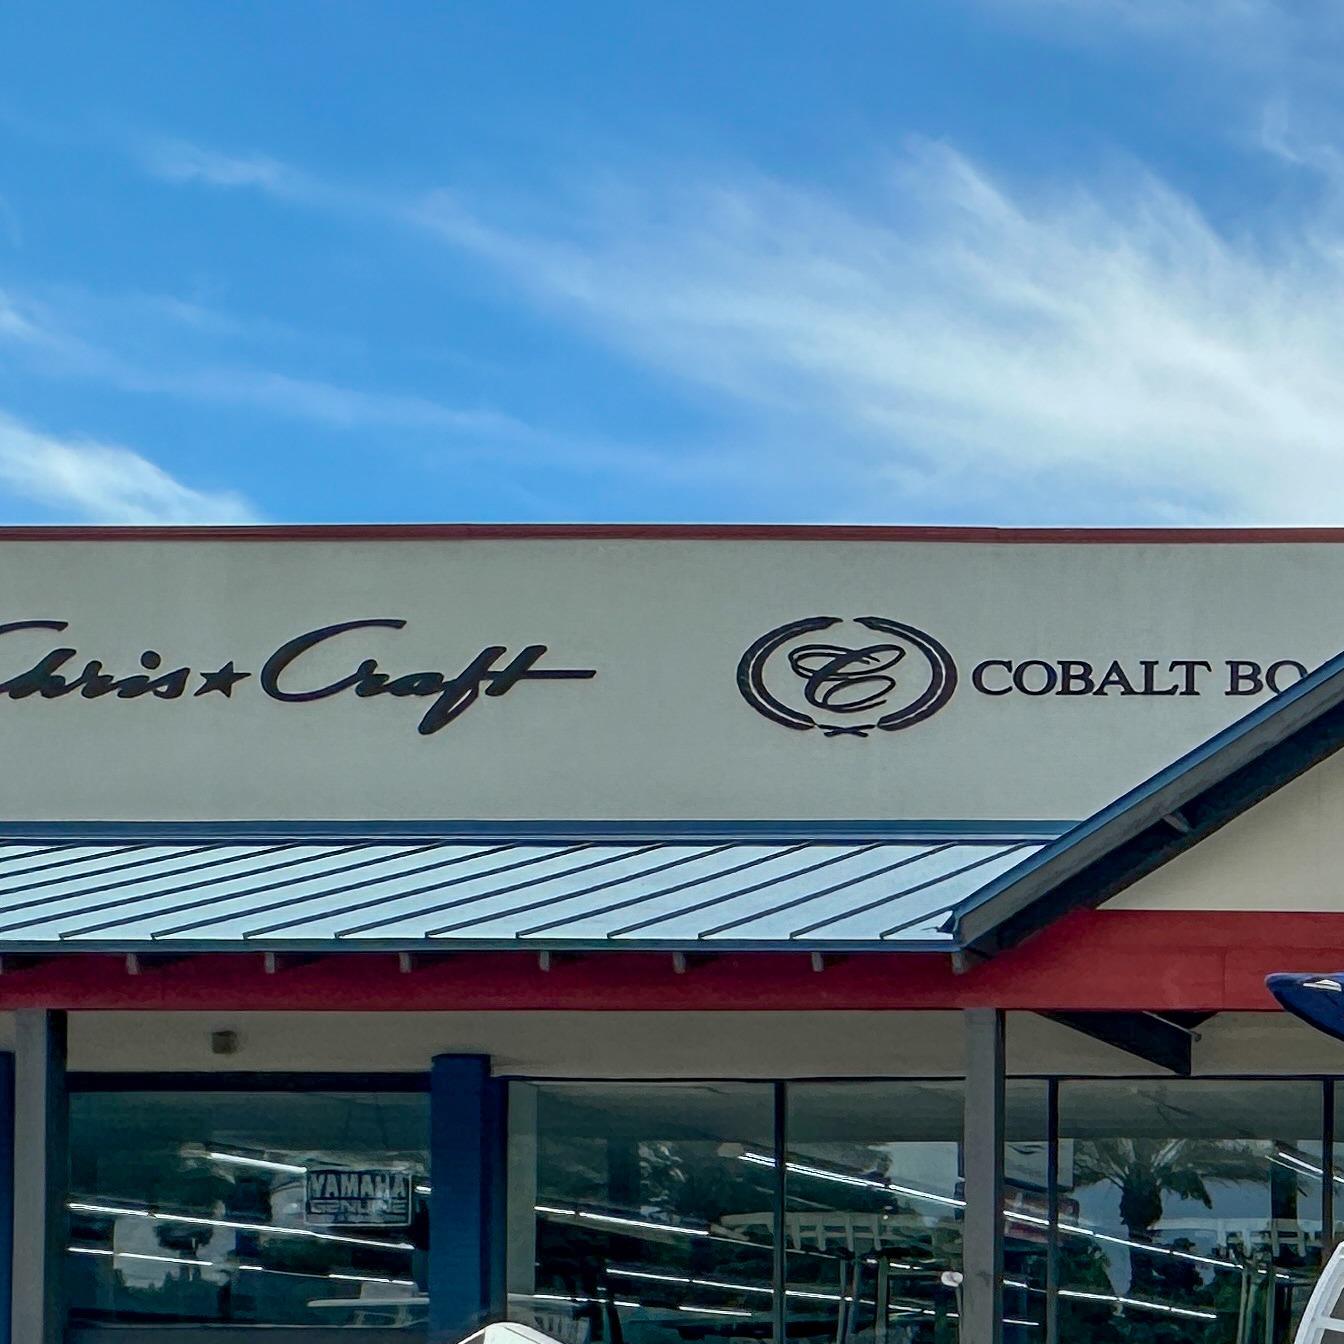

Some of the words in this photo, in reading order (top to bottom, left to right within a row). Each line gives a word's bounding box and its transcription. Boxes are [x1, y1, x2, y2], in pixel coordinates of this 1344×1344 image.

[261, 619, 597, 736] Craft
[971, 659, 1213, 697] COBALT
[309, 1172, 407, 1198] YAMAHA
